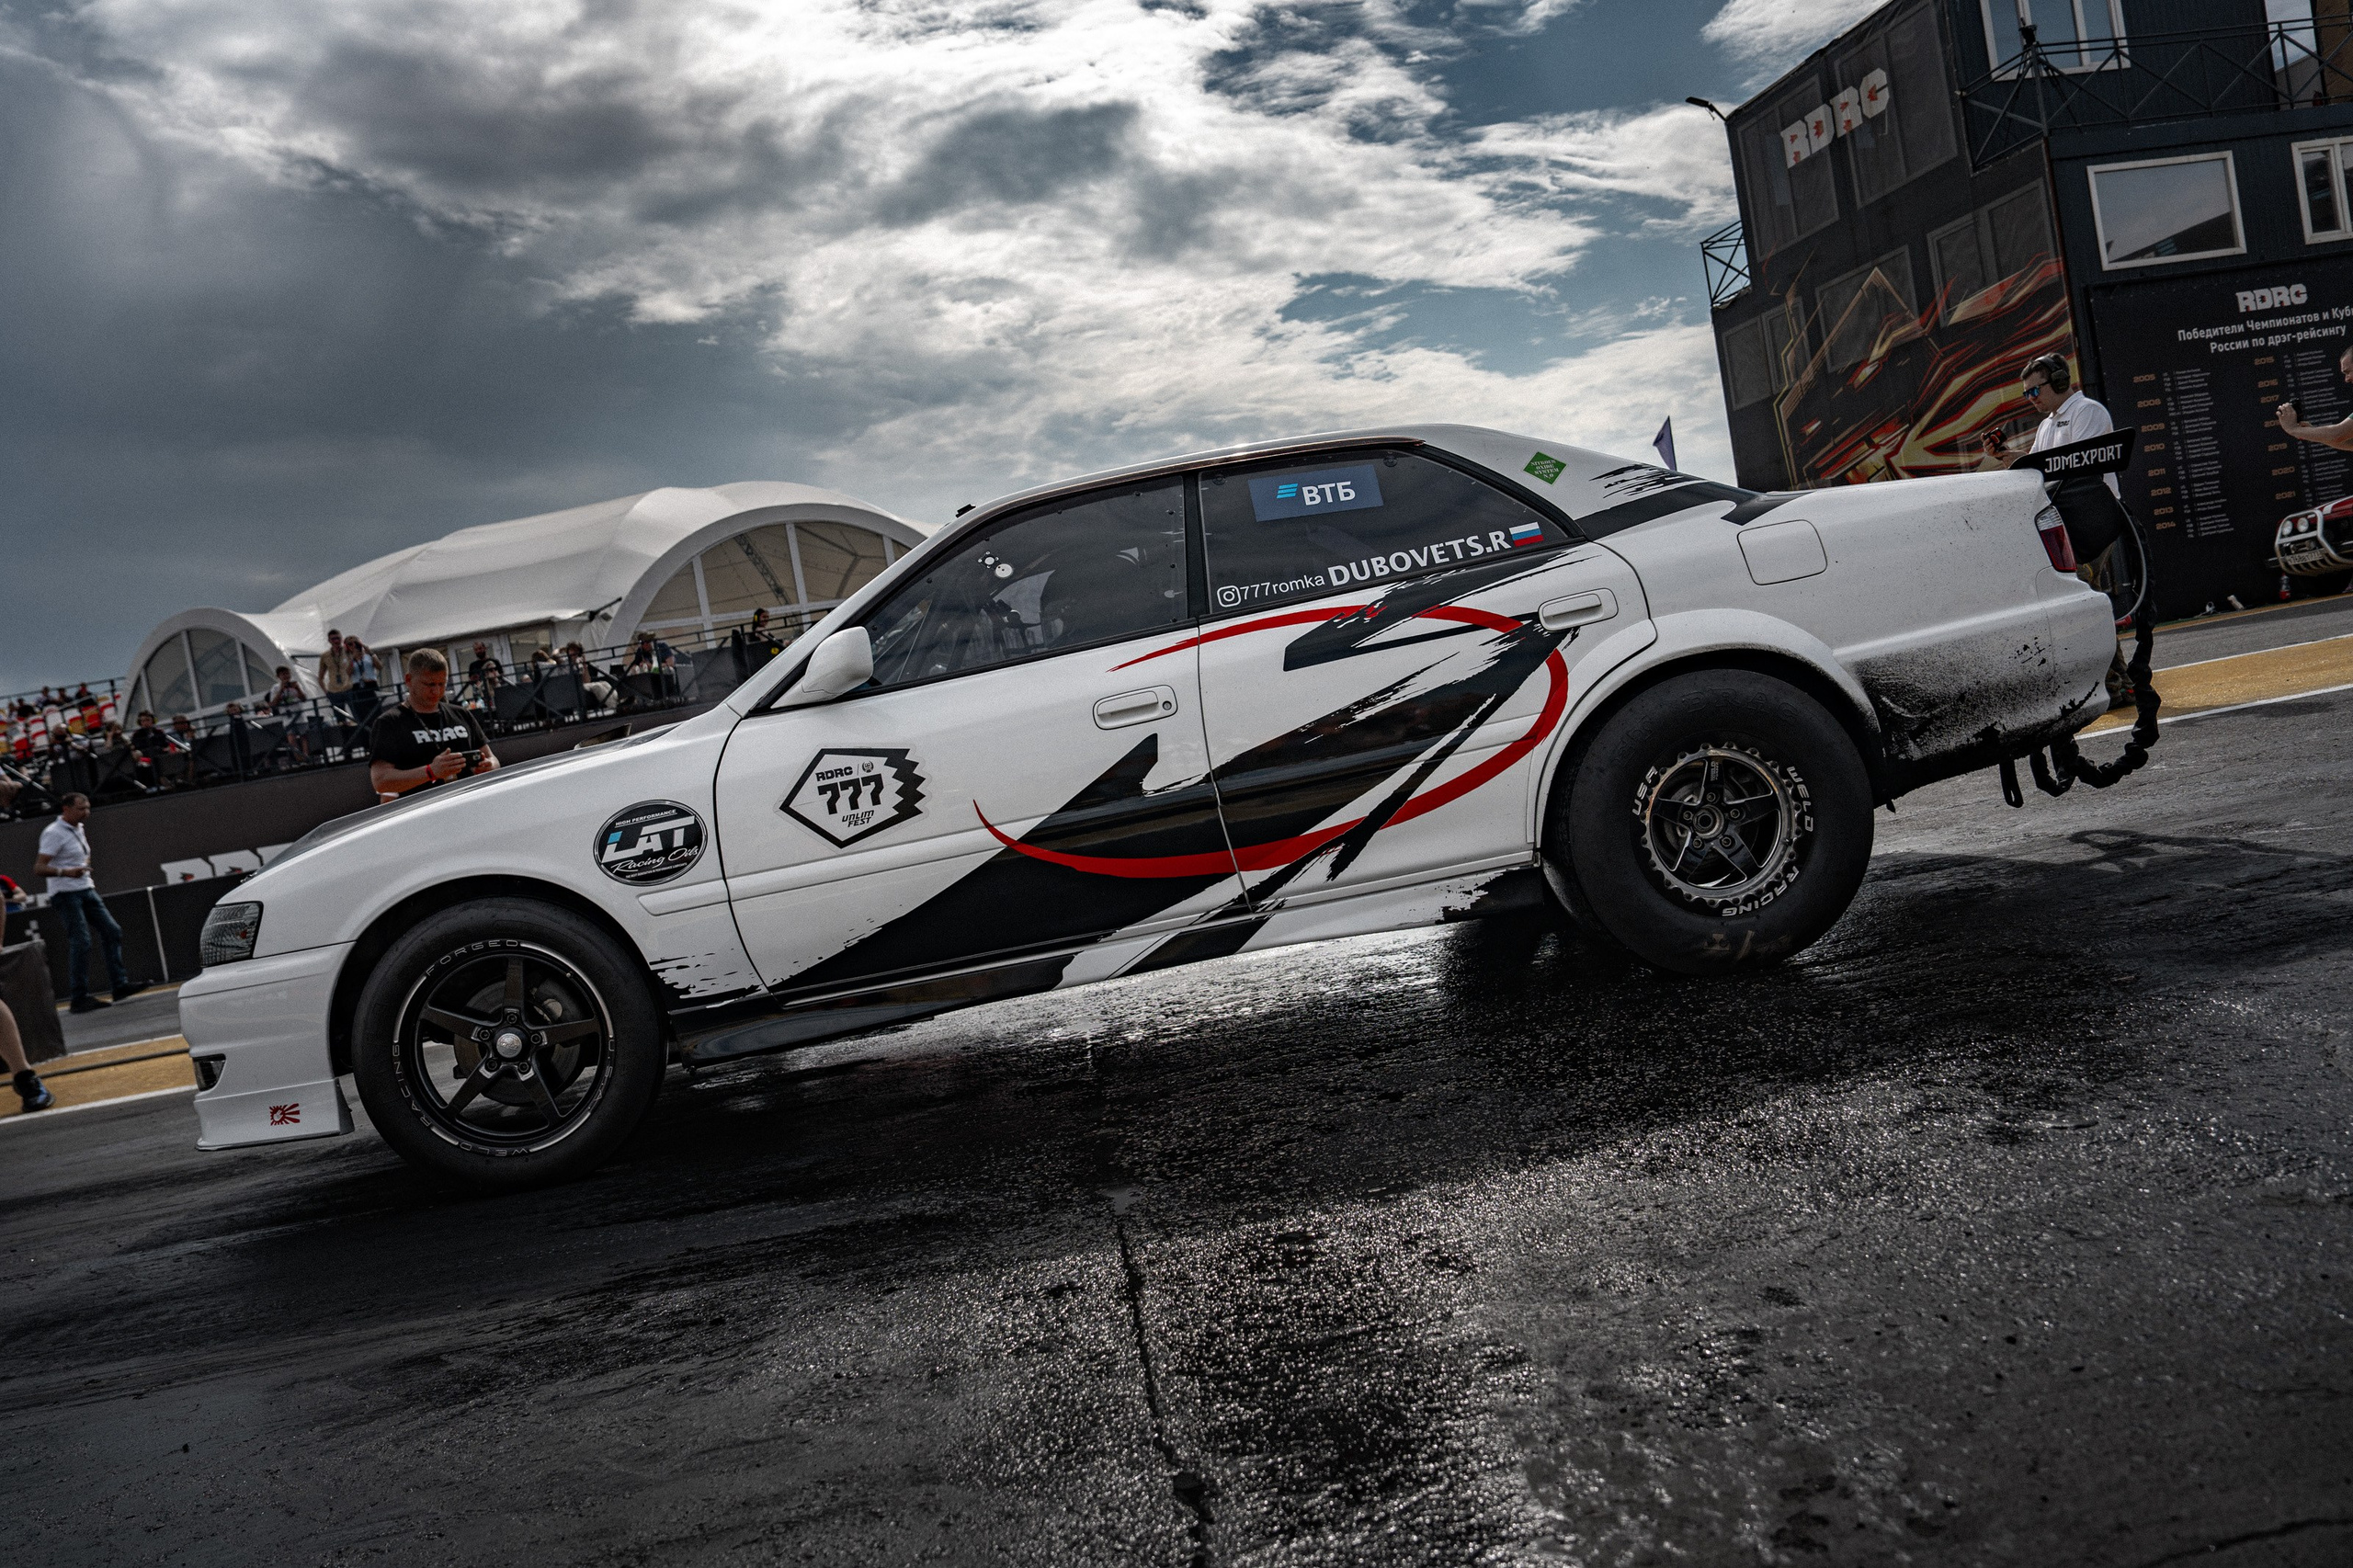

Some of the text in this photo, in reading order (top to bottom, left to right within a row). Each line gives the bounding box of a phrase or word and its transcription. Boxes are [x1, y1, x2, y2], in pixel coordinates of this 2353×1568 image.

[1780, 67, 1890, 169] RDRC
[2235, 283, 2308, 312] RDRC
[2177, 324, 2245, 341] Победители
[2246, 313, 2320, 332] Чемпионатов
[2322, 311, 2330, 321] и
[2210, 324, 2347, 354] России по дрэг-рейсингу
[2260, 394, 2279, 403] 2017
[2044, 443, 2123, 473] JDMEXPORT
[2143, 443, 2165, 452] 2010
[2147, 468, 2165, 477] 2011
[1302, 481, 1357, 506] ВТБ
[2151, 487, 2171, 496] 2012
[2155, 521, 2177, 530] 2014
[1239, 530, 1512, 600] 777romka DUBOVETS.R
[815, 766, 853, 781] RDRC
[817, 773, 884, 815] 777
[1631, 765, 1659, 816] USA
[1786, 766, 1814, 832] WELD
[631, 809, 676, 823] PERFORMANCE
[842, 810, 875, 823] UNLIM
[847, 817, 872, 828] FEST
[610, 856, 666, 874] Racing
[668, 845, 699, 861] Oils
[1722, 865, 1800, 917] RACING
[426, 939, 518, 977] FORGED
[392, 1044, 433, 1128] RACING
[459, 1142, 529, 1157] WELD
